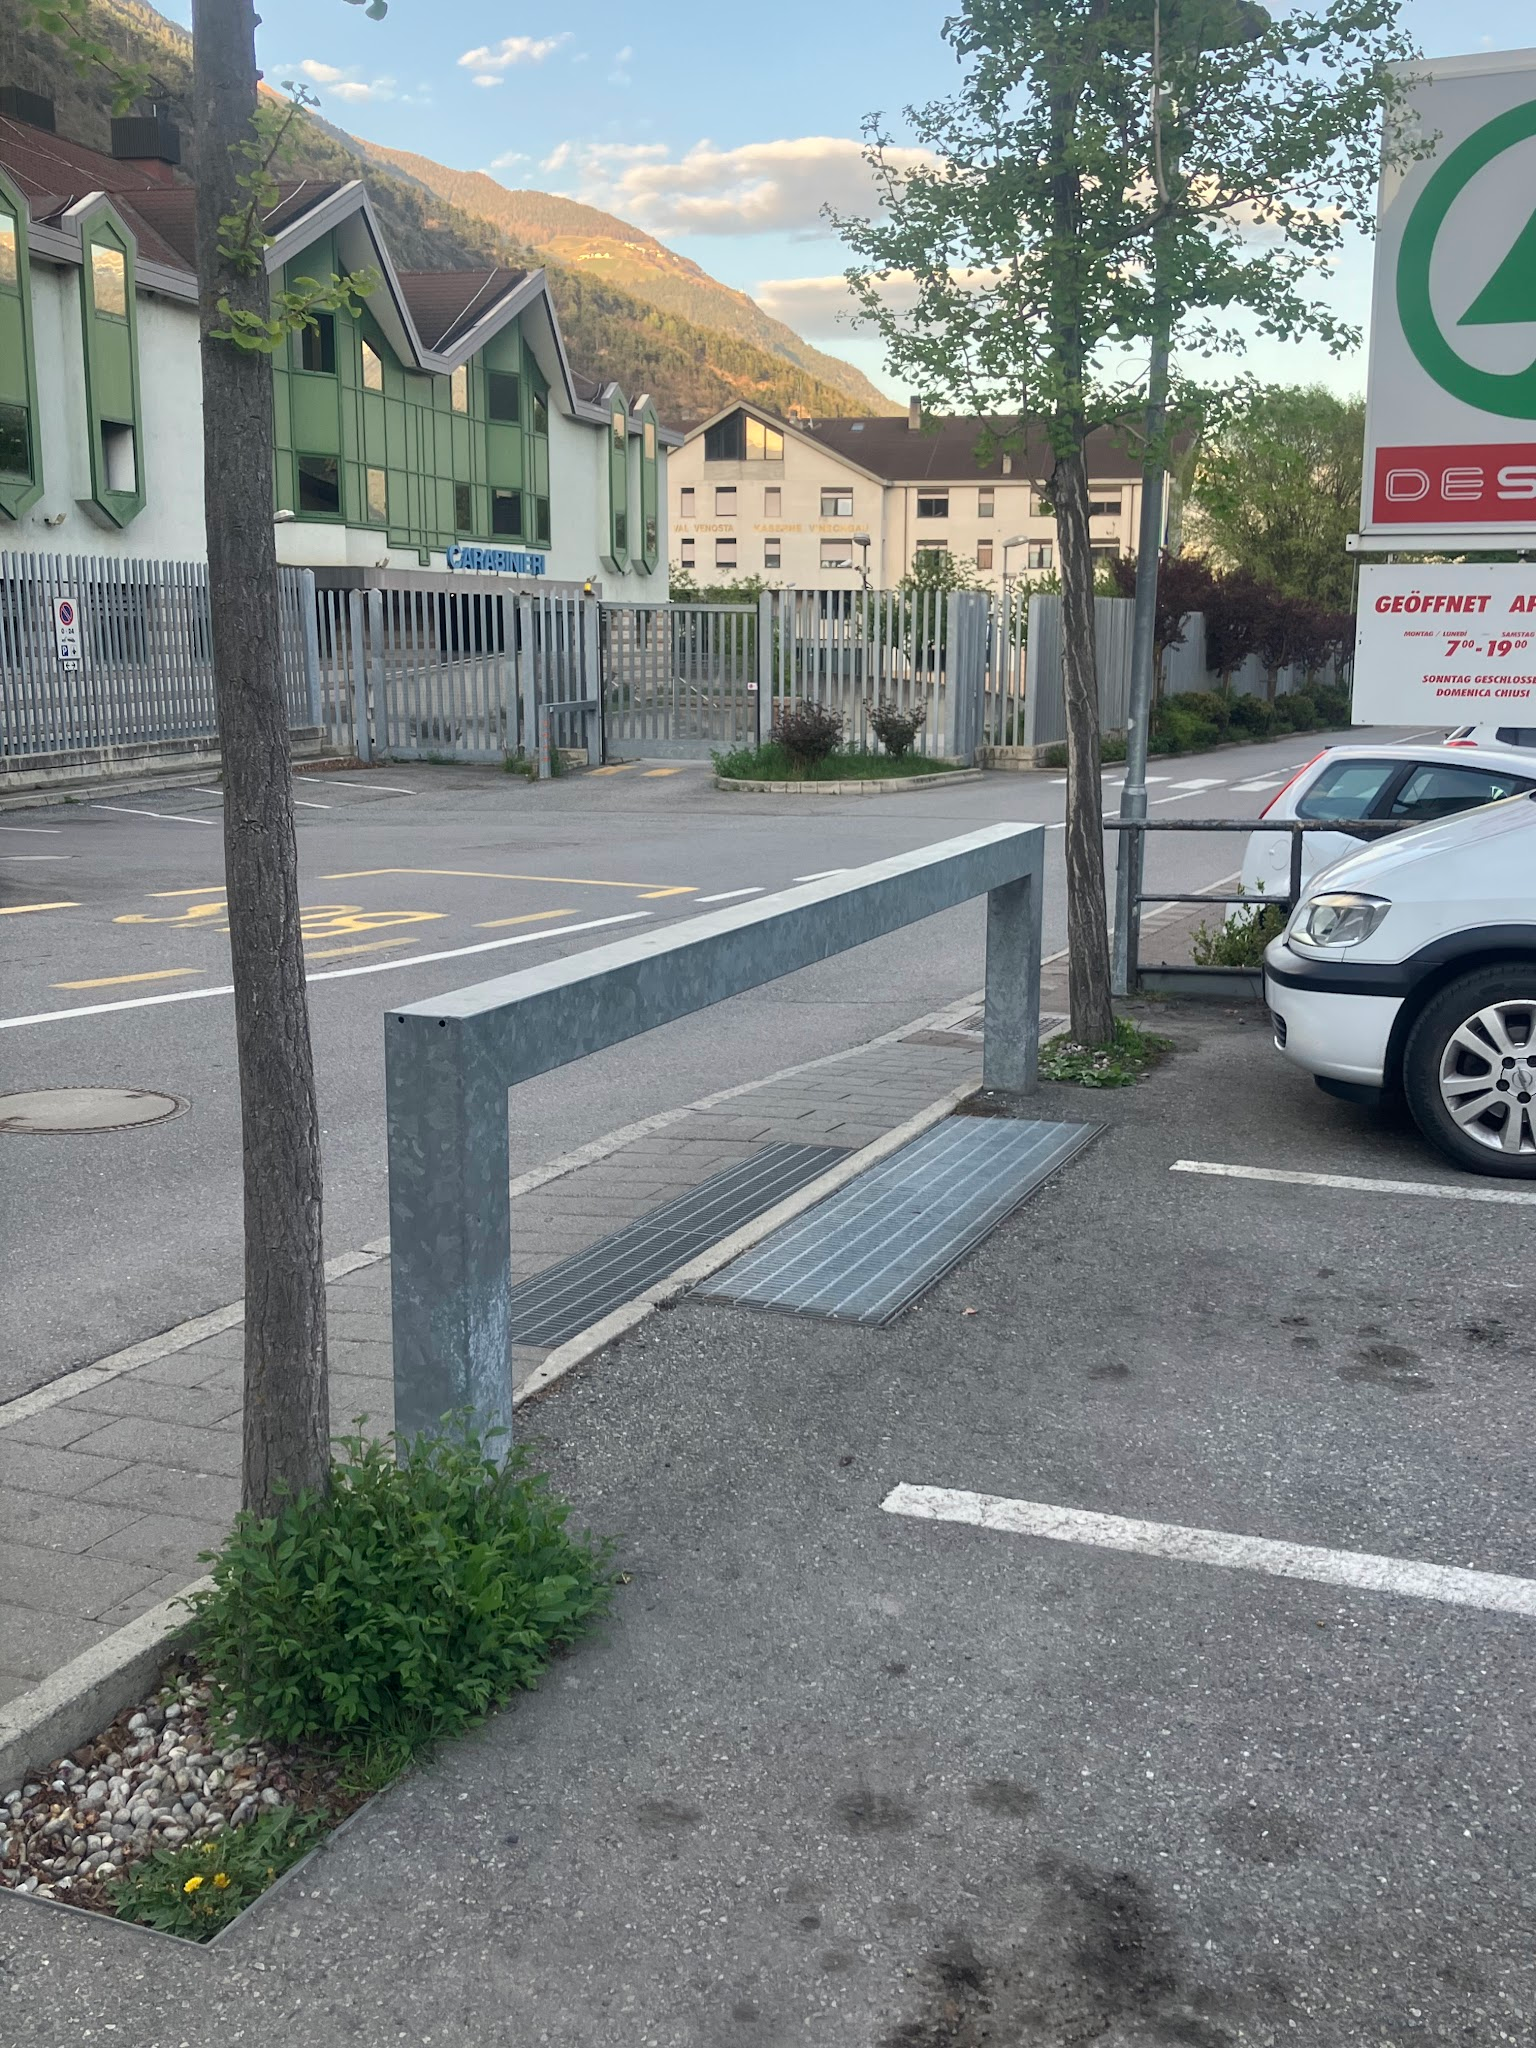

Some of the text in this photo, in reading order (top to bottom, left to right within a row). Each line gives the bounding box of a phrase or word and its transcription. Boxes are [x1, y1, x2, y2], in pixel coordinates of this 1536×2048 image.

[1386, 465, 1536, 502] DES
[694, 524, 734, 532] VENOSTA
[446, 544, 546, 576] CARABINIERI
[1375, 590, 1492, 613] GEÖFFNET
[1422, 675, 1472, 684] SONNTAG
[1436, 688, 1530, 698] DOMENICA CHIUSI
